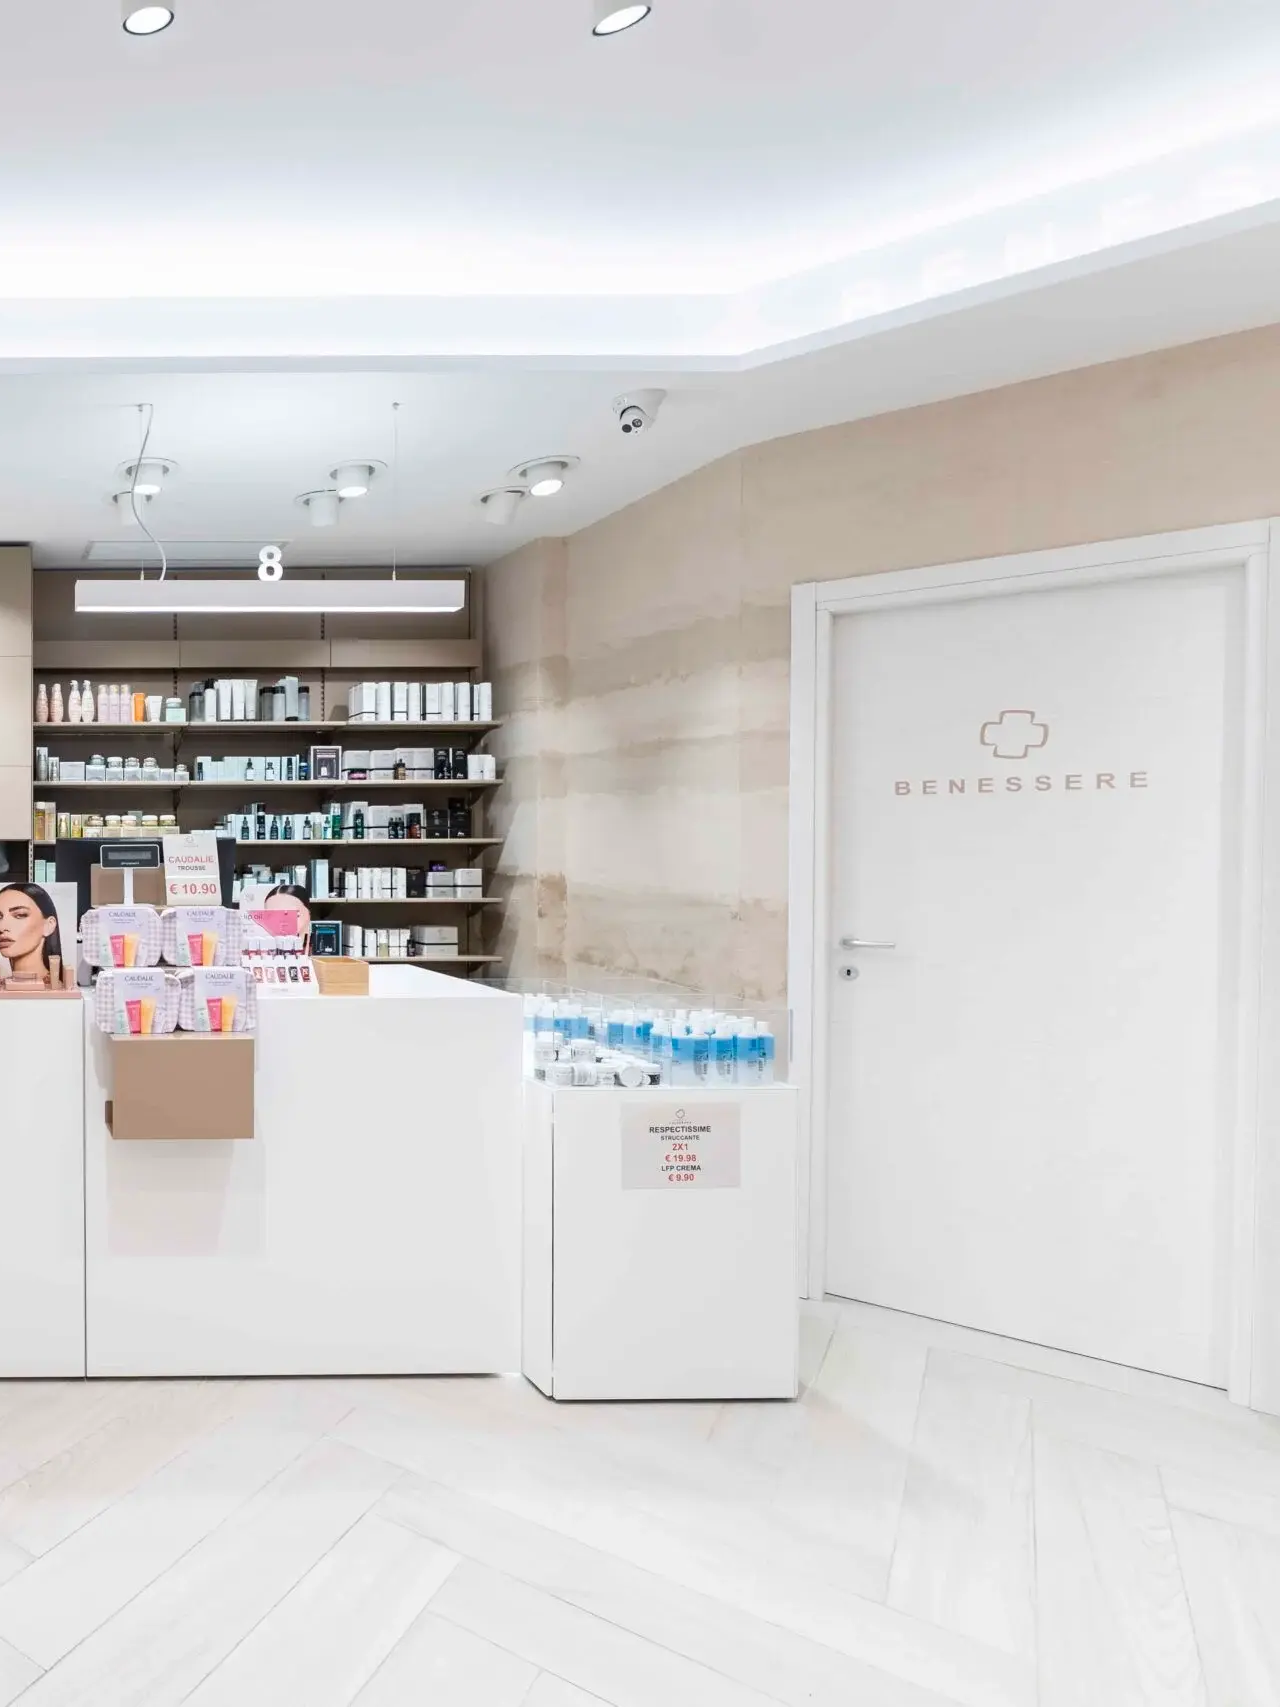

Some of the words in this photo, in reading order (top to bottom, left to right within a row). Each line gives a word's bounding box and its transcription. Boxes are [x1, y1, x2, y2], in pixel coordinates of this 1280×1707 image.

[258, 545, 283, 581] 8
[894, 771, 1148, 796] BENESSERE
[168, 855, 215, 864] CAUDALIE
[169, 884, 178, 895] €
[182, 883, 217, 895] 10.90
[672, 1143, 688, 1151] 2X1
[665, 1154, 671, 1162] €
[673, 1154, 697, 1162] 19.98
